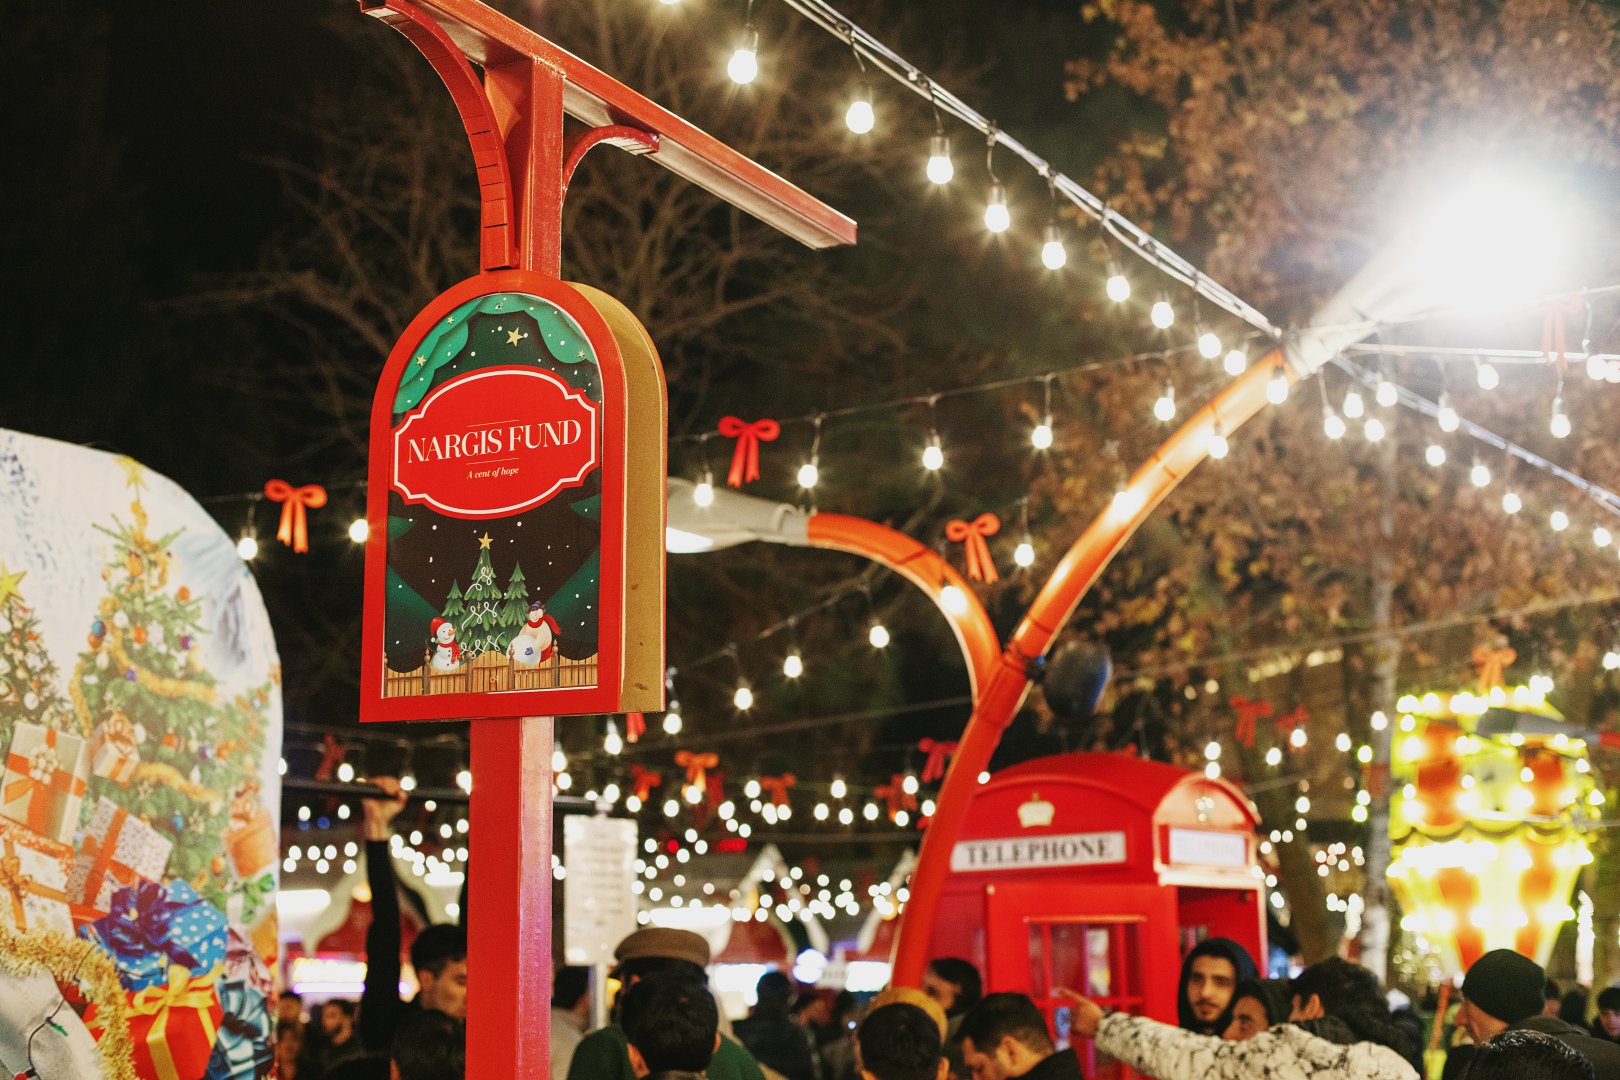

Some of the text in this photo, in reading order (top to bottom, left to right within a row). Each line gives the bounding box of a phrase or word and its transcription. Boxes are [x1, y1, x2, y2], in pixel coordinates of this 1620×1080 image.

[407, 419, 582, 464] NARGIS FUND
[466, 466, 520, 480] A cent of hope
[966, 838, 1109, 866] TELEPHONE
